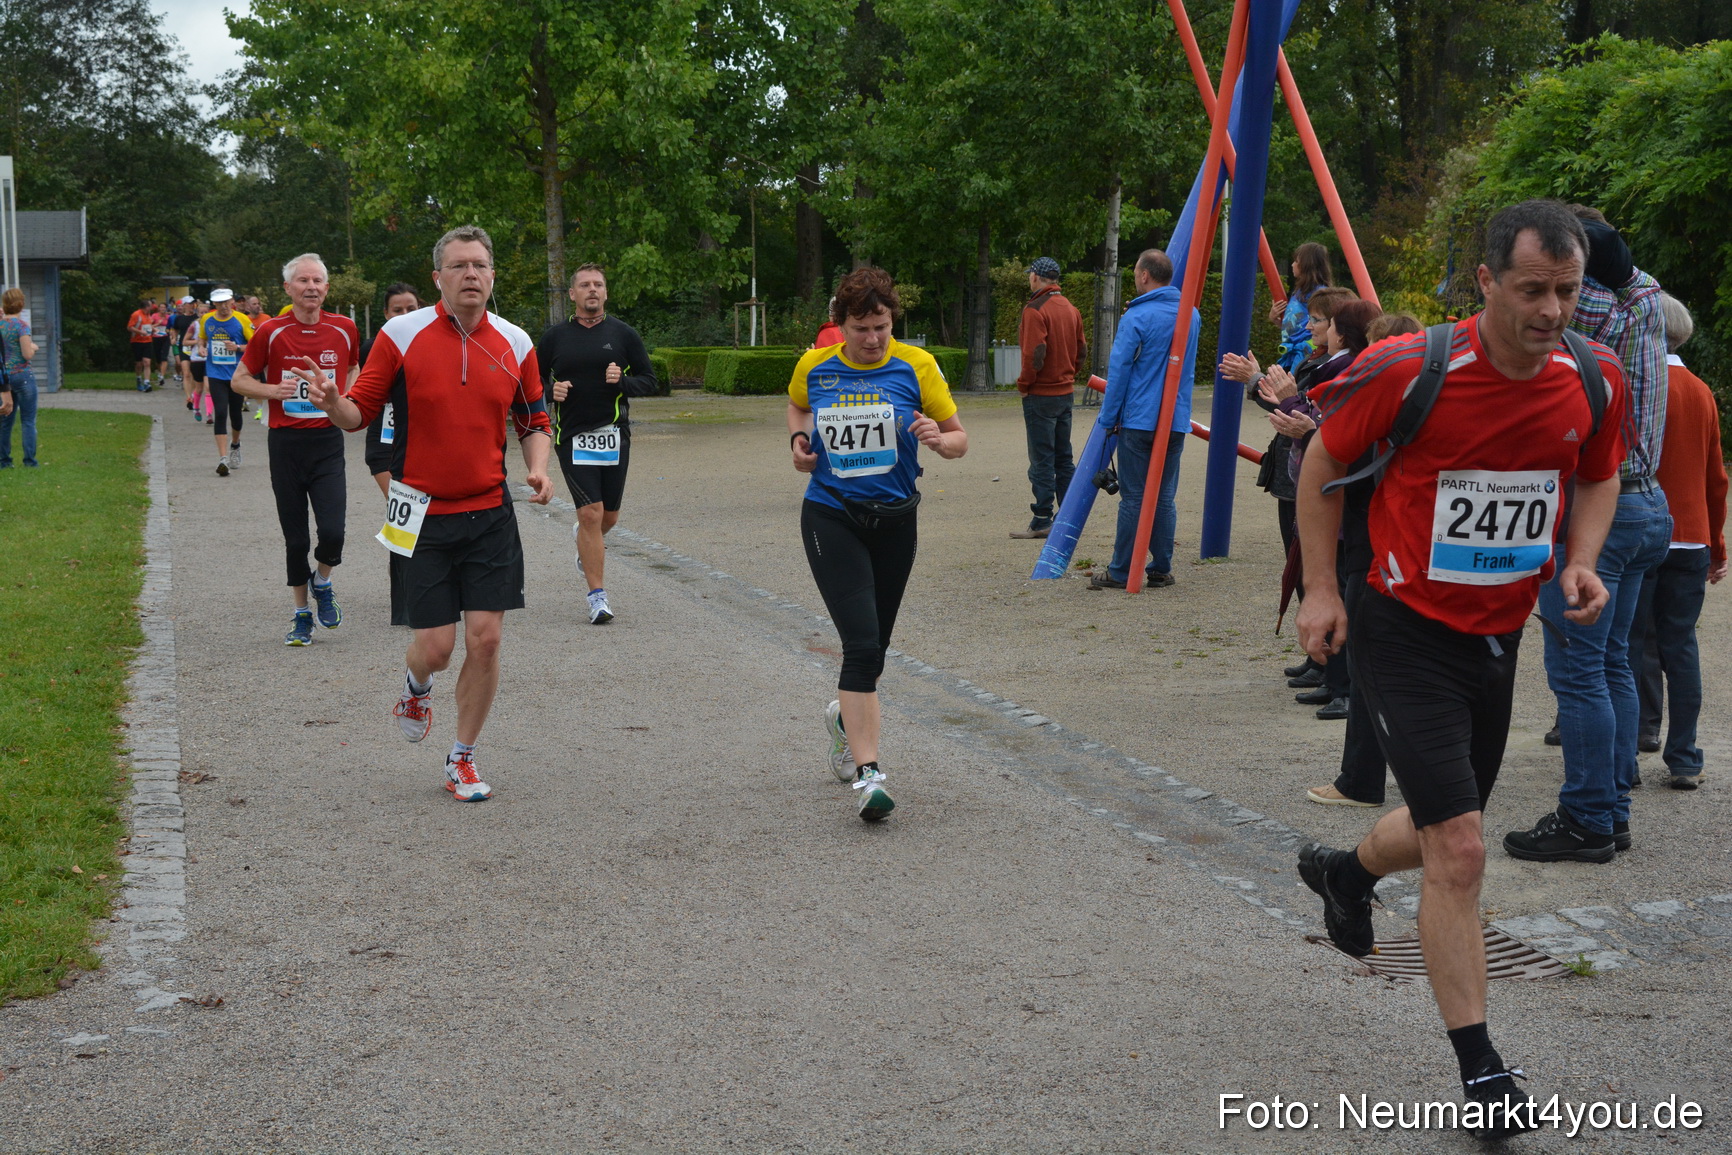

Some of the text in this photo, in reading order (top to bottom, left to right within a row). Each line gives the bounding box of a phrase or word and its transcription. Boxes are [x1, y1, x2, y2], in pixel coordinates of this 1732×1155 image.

[301, 403, 320, 412] Hors
[842, 412, 880, 421] Neumarkt
[577, 434, 617, 450] 3390
[825, 422, 886, 451] 2471
[840, 456, 876, 468] Marion
[390, 486, 418, 501] Neumarkt
[1441, 478, 1541, 494] PARTL Neumarkt
[387, 495, 412, 527] 09
[1446, 497, 1548, 541] 2470
[1473, 552, 1516, 569] Frank
